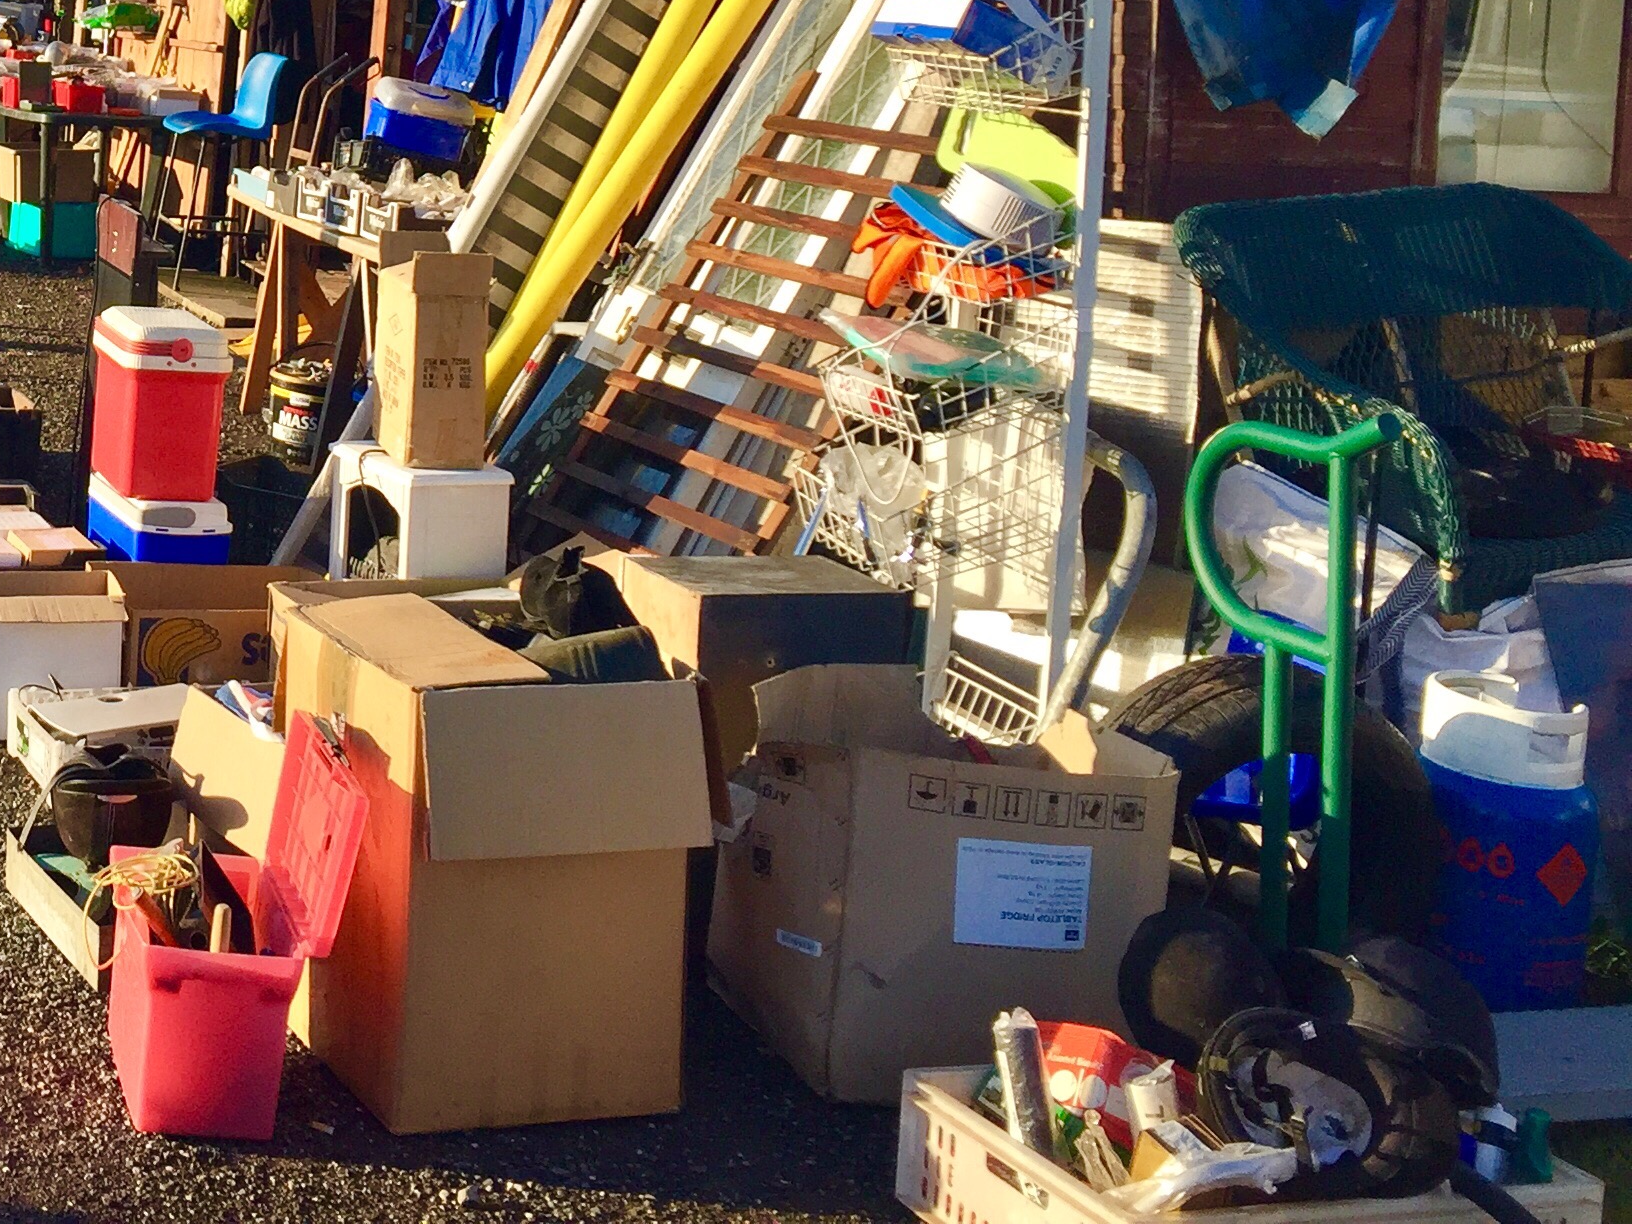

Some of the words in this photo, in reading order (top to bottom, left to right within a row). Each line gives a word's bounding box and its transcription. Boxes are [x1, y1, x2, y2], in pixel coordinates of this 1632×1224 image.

[278, 409, 319, 432] MASS
[758, 782, 791, 806] Arg
[1000, 910, 1035, 922] FRIDGE
[1037, 914, 1083, 924] TABLETOP
